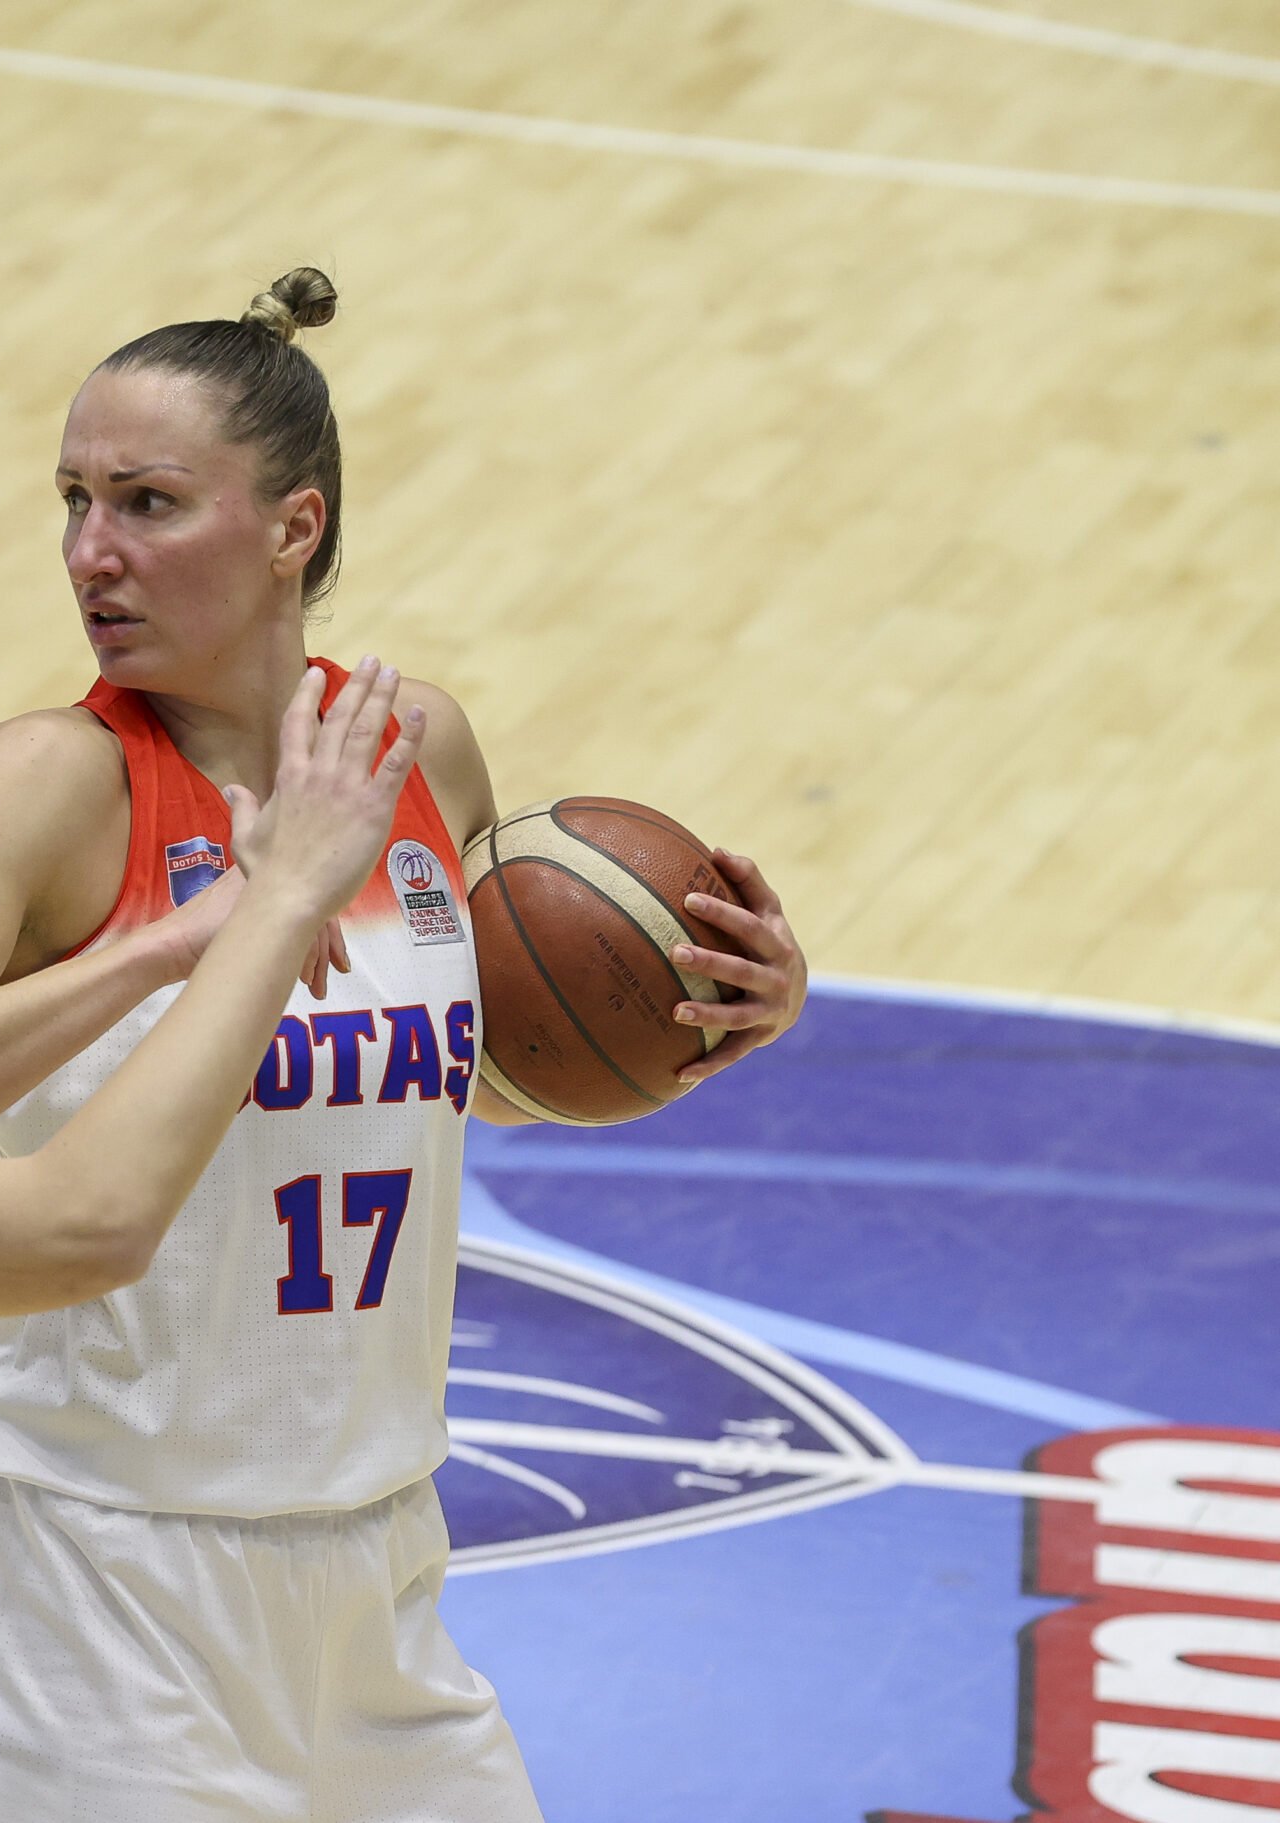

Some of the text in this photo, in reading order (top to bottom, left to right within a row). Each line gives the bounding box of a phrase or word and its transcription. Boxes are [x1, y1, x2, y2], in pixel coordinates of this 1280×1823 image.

[409, 907, 450, 918] KADINLAR
[409, 916, 457, 928] BASKETBOL
[237, 1000, 475, 1116] OTAŞ
[273, 1168, 413, 1315] 17
